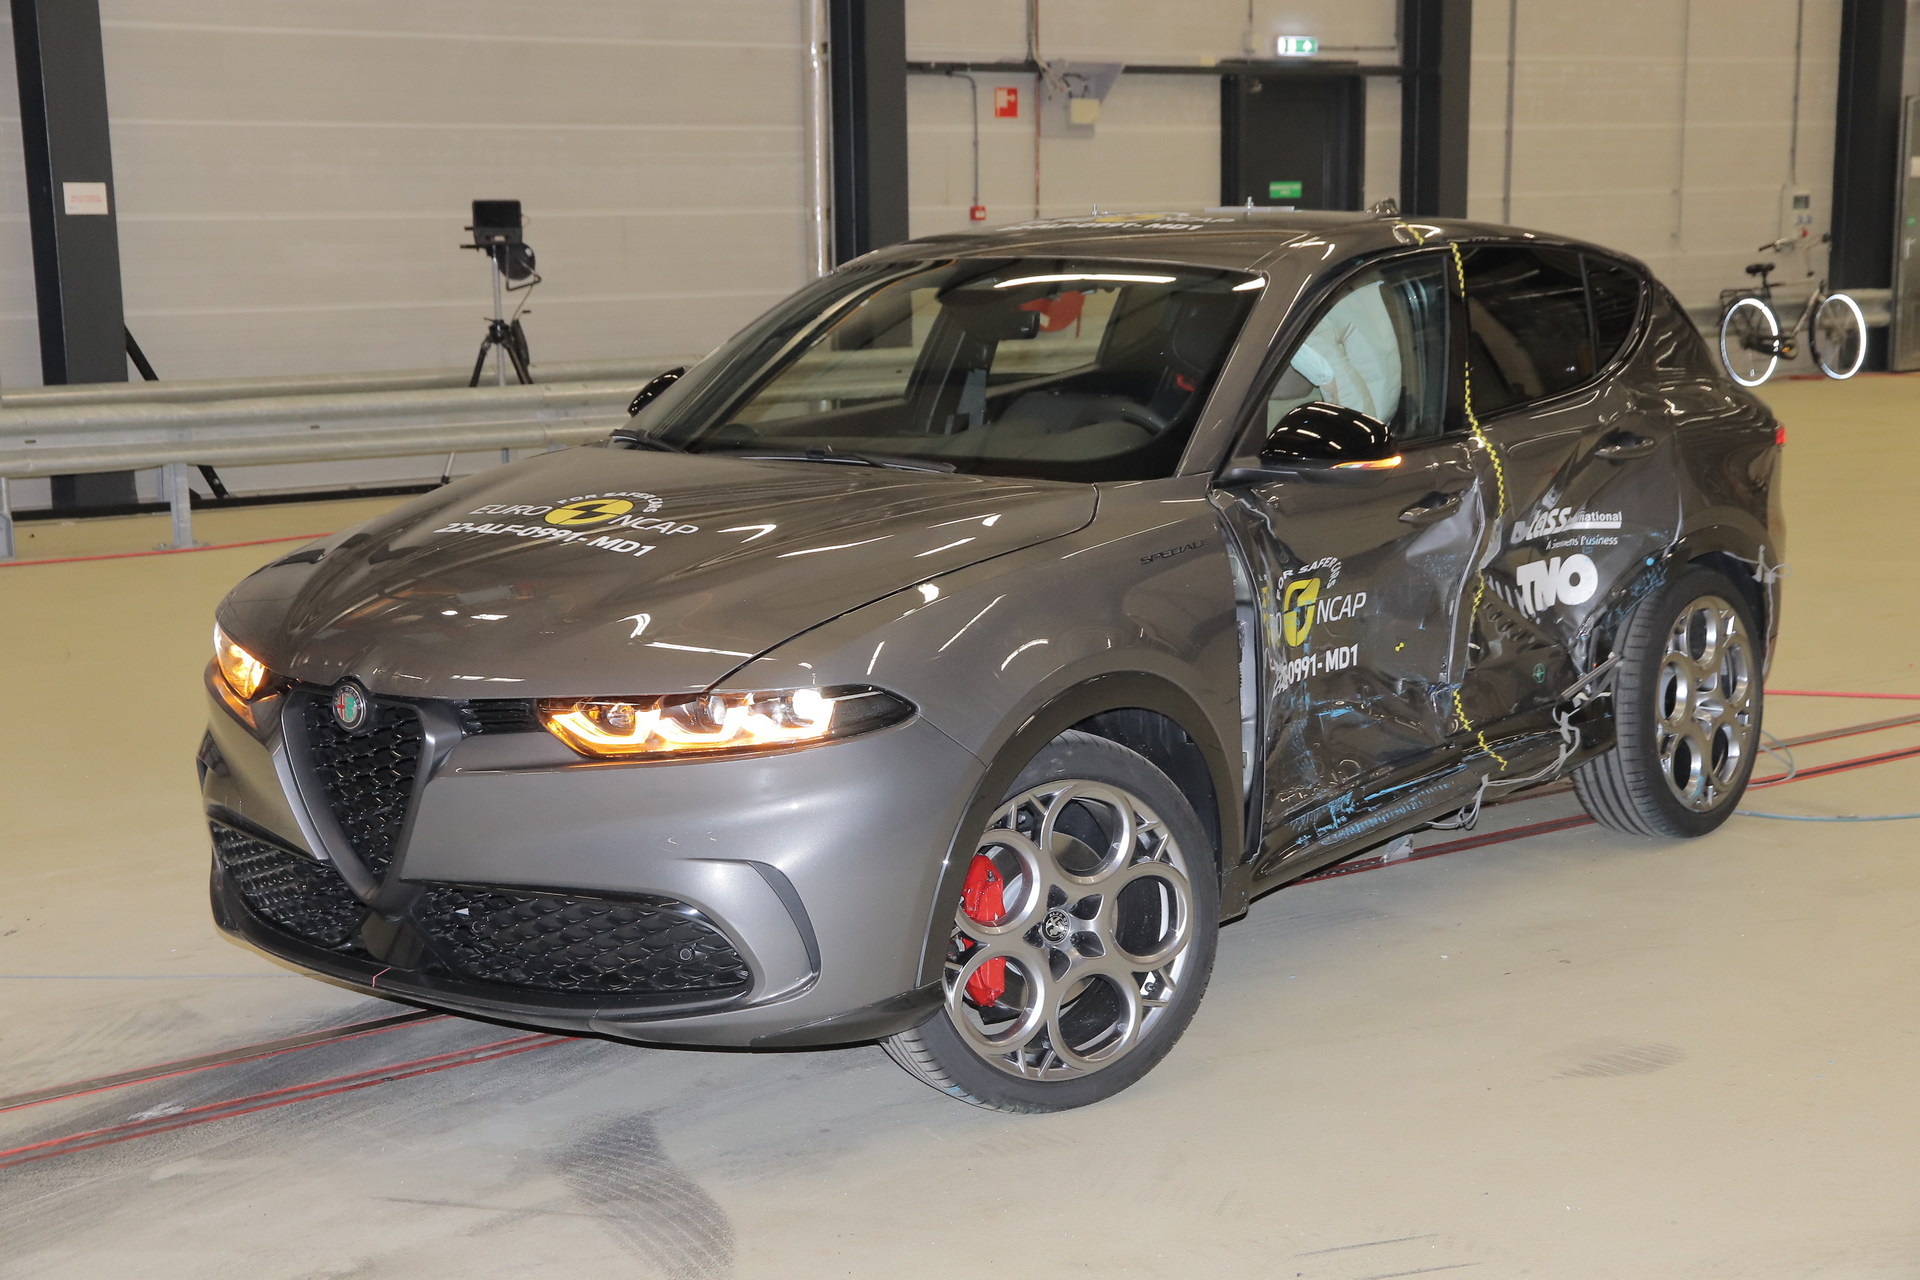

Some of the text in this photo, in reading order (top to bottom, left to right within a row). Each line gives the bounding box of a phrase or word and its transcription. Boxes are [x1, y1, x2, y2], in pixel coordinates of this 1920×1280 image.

[556, 494, 597, 504] FOR
[468, 504, 553, 516] EURO
[608, 514, 700, 535] NCAP
[1297, 556, 1338, 574] SAFER
[1516, 553, 1599, 615] TNO
[1315, 592, 1367, 625] NCAP
